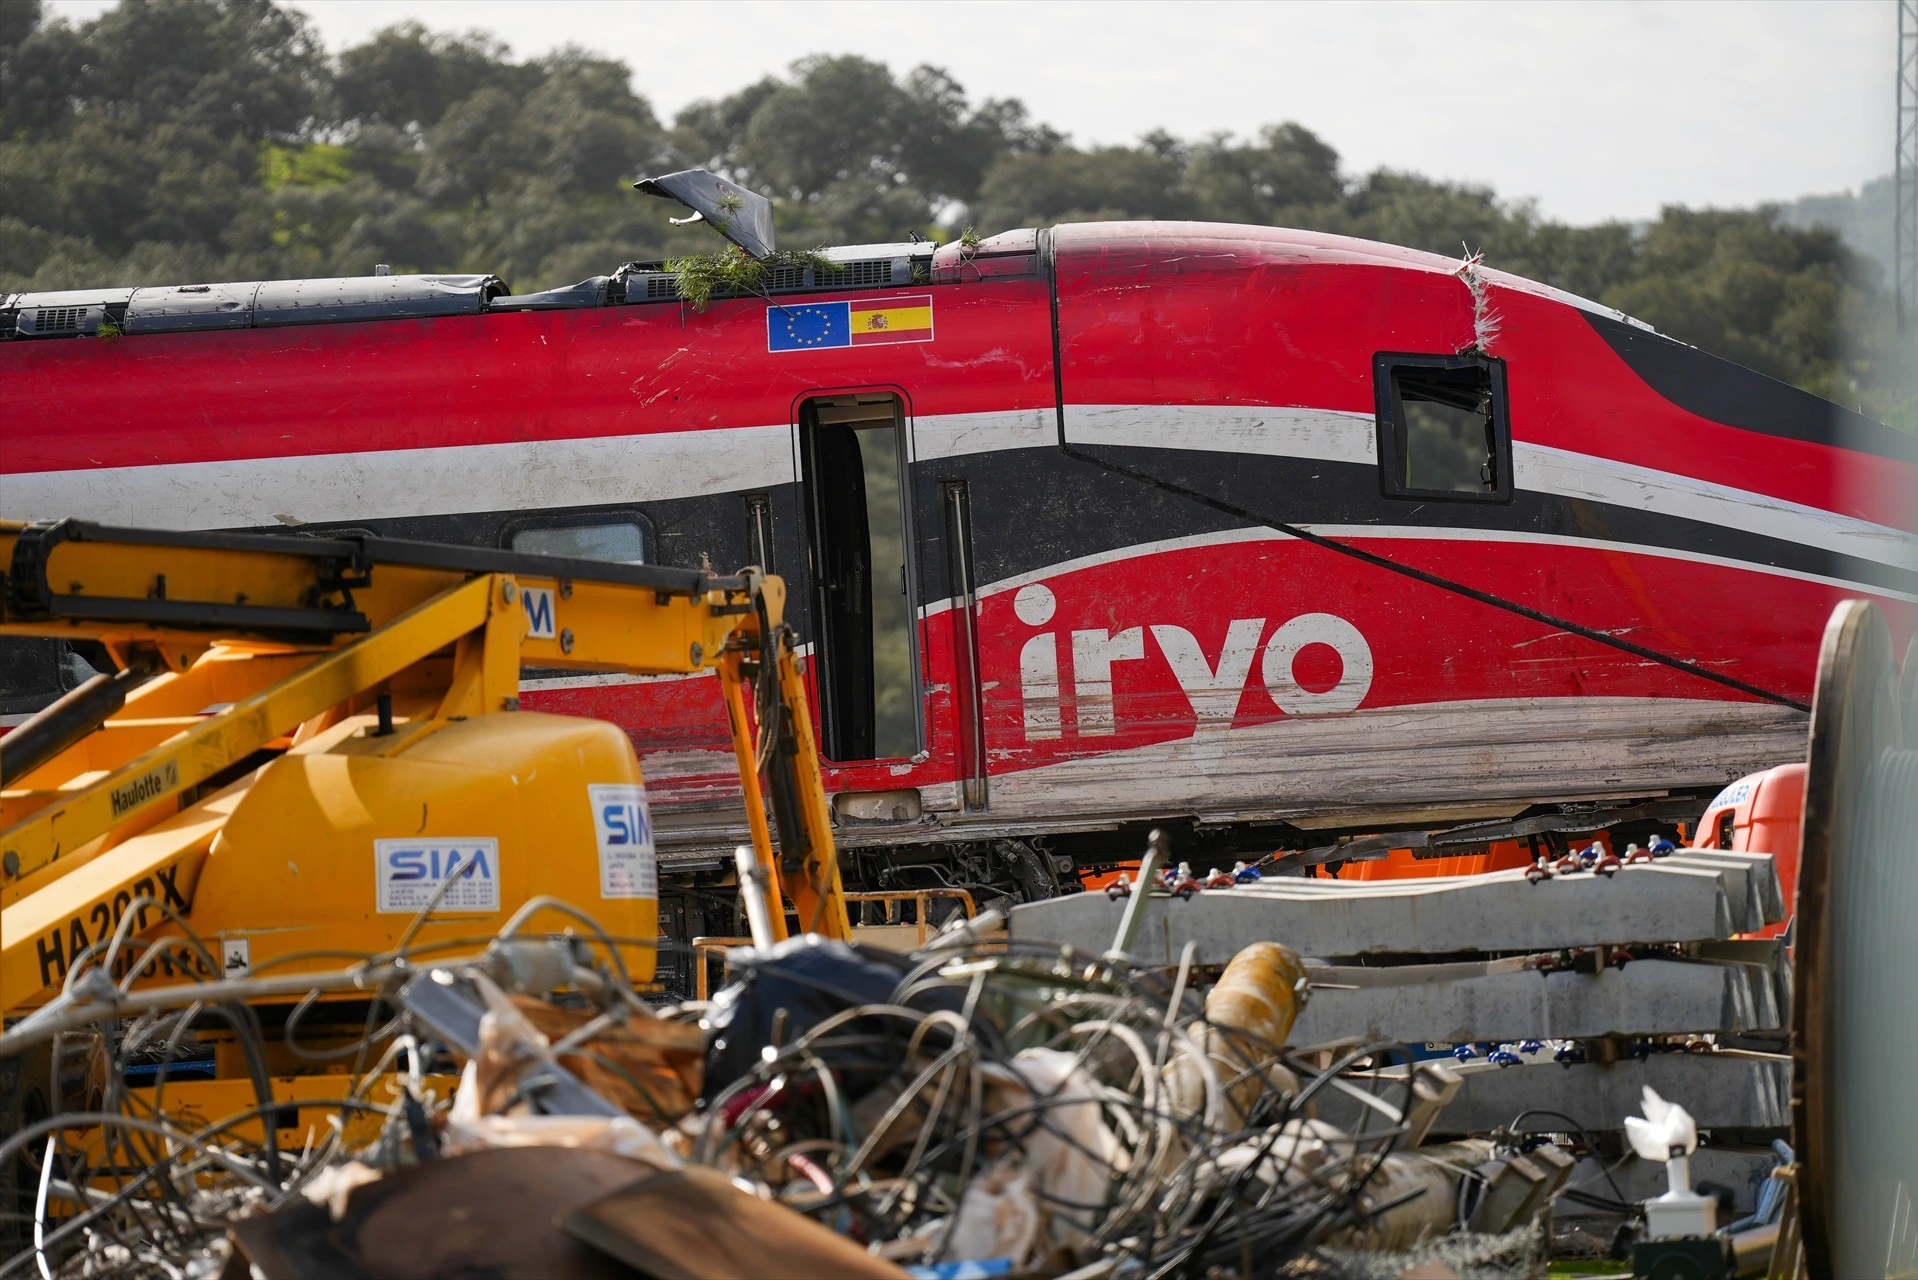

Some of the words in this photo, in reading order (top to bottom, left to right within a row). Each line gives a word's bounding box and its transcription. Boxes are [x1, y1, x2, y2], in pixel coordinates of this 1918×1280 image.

[1014, 583, 1374, 771] iryo
[110, 773, 162, 815] Haulotte
[389, 849, 491, 880] SIM
[36, 864, 191, 987] HA20PX
